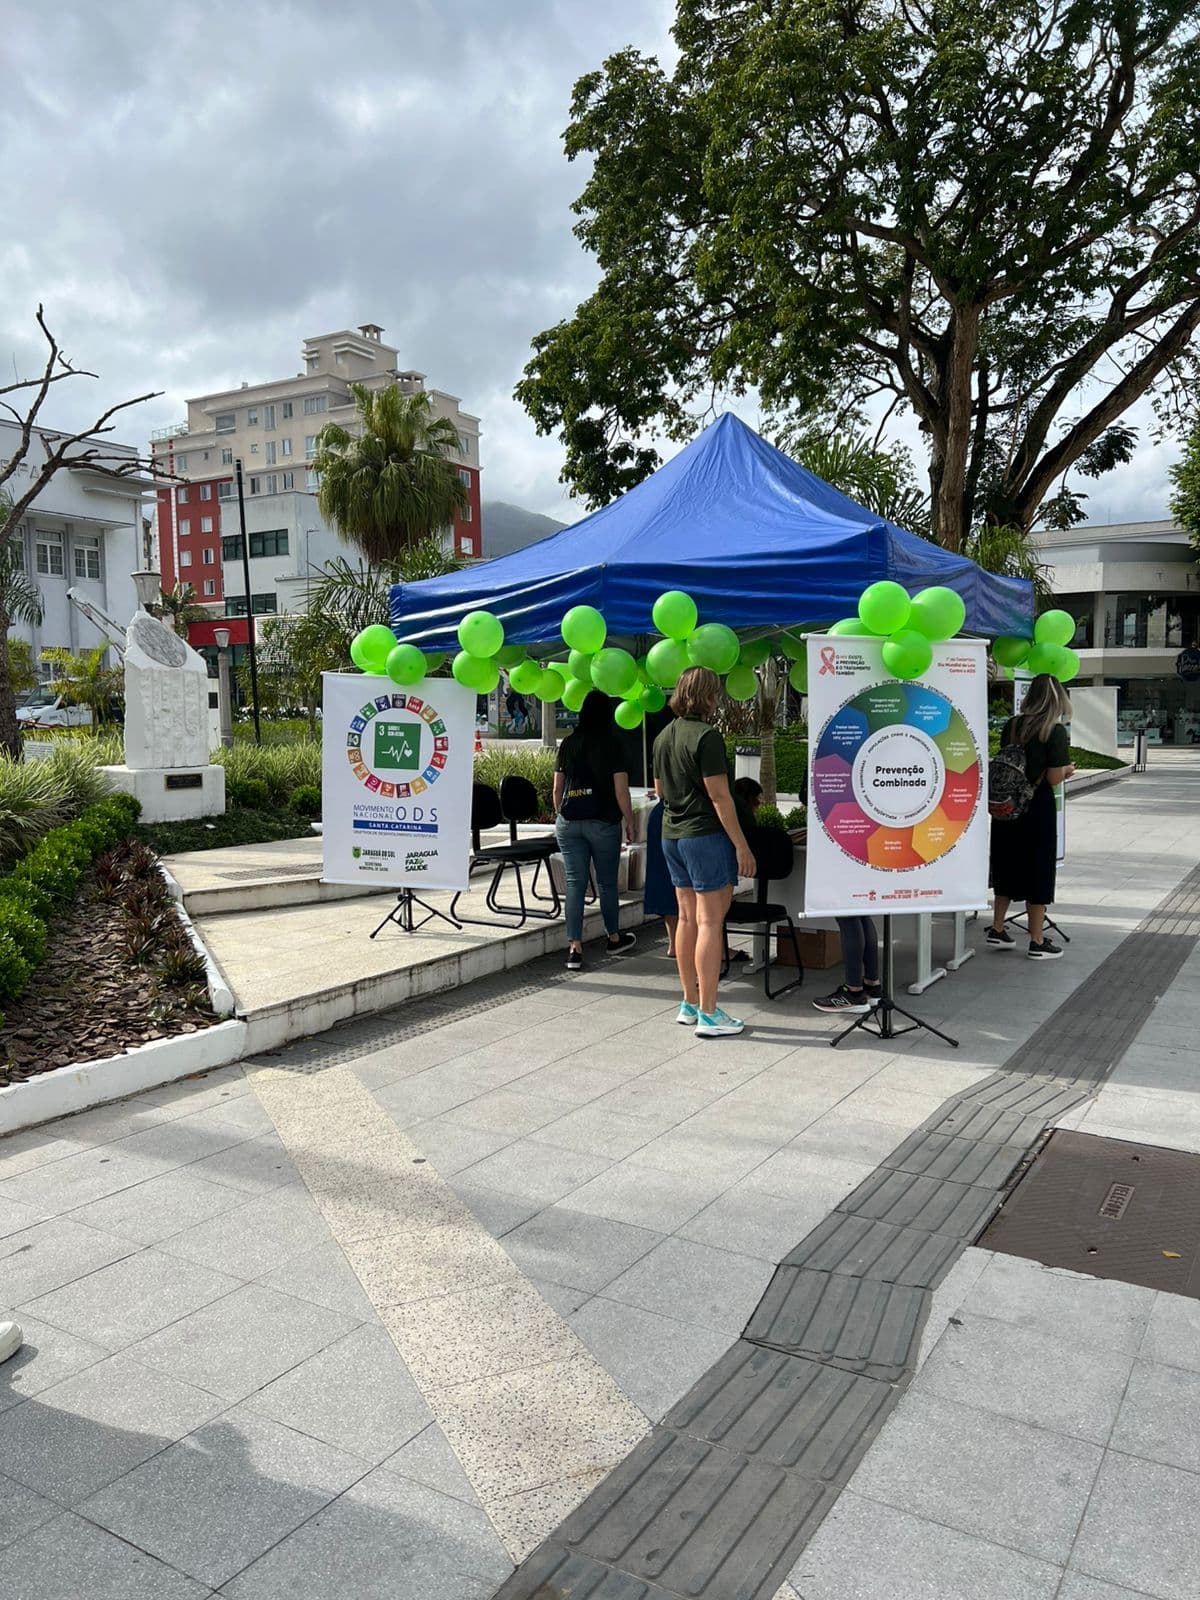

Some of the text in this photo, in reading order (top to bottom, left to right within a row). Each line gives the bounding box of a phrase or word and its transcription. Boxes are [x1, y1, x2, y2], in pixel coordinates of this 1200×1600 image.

[379, 725, 385, 736] 3
[875, 765, 924, 776] Prevenção
[872, 778, 926, 787] Combinada
[354, 804, 394, 813] MOVIMENTO
[354, 812, 393, 820] NACIONAL
[1102, 1186, 1130, 1218] TELEFONE
